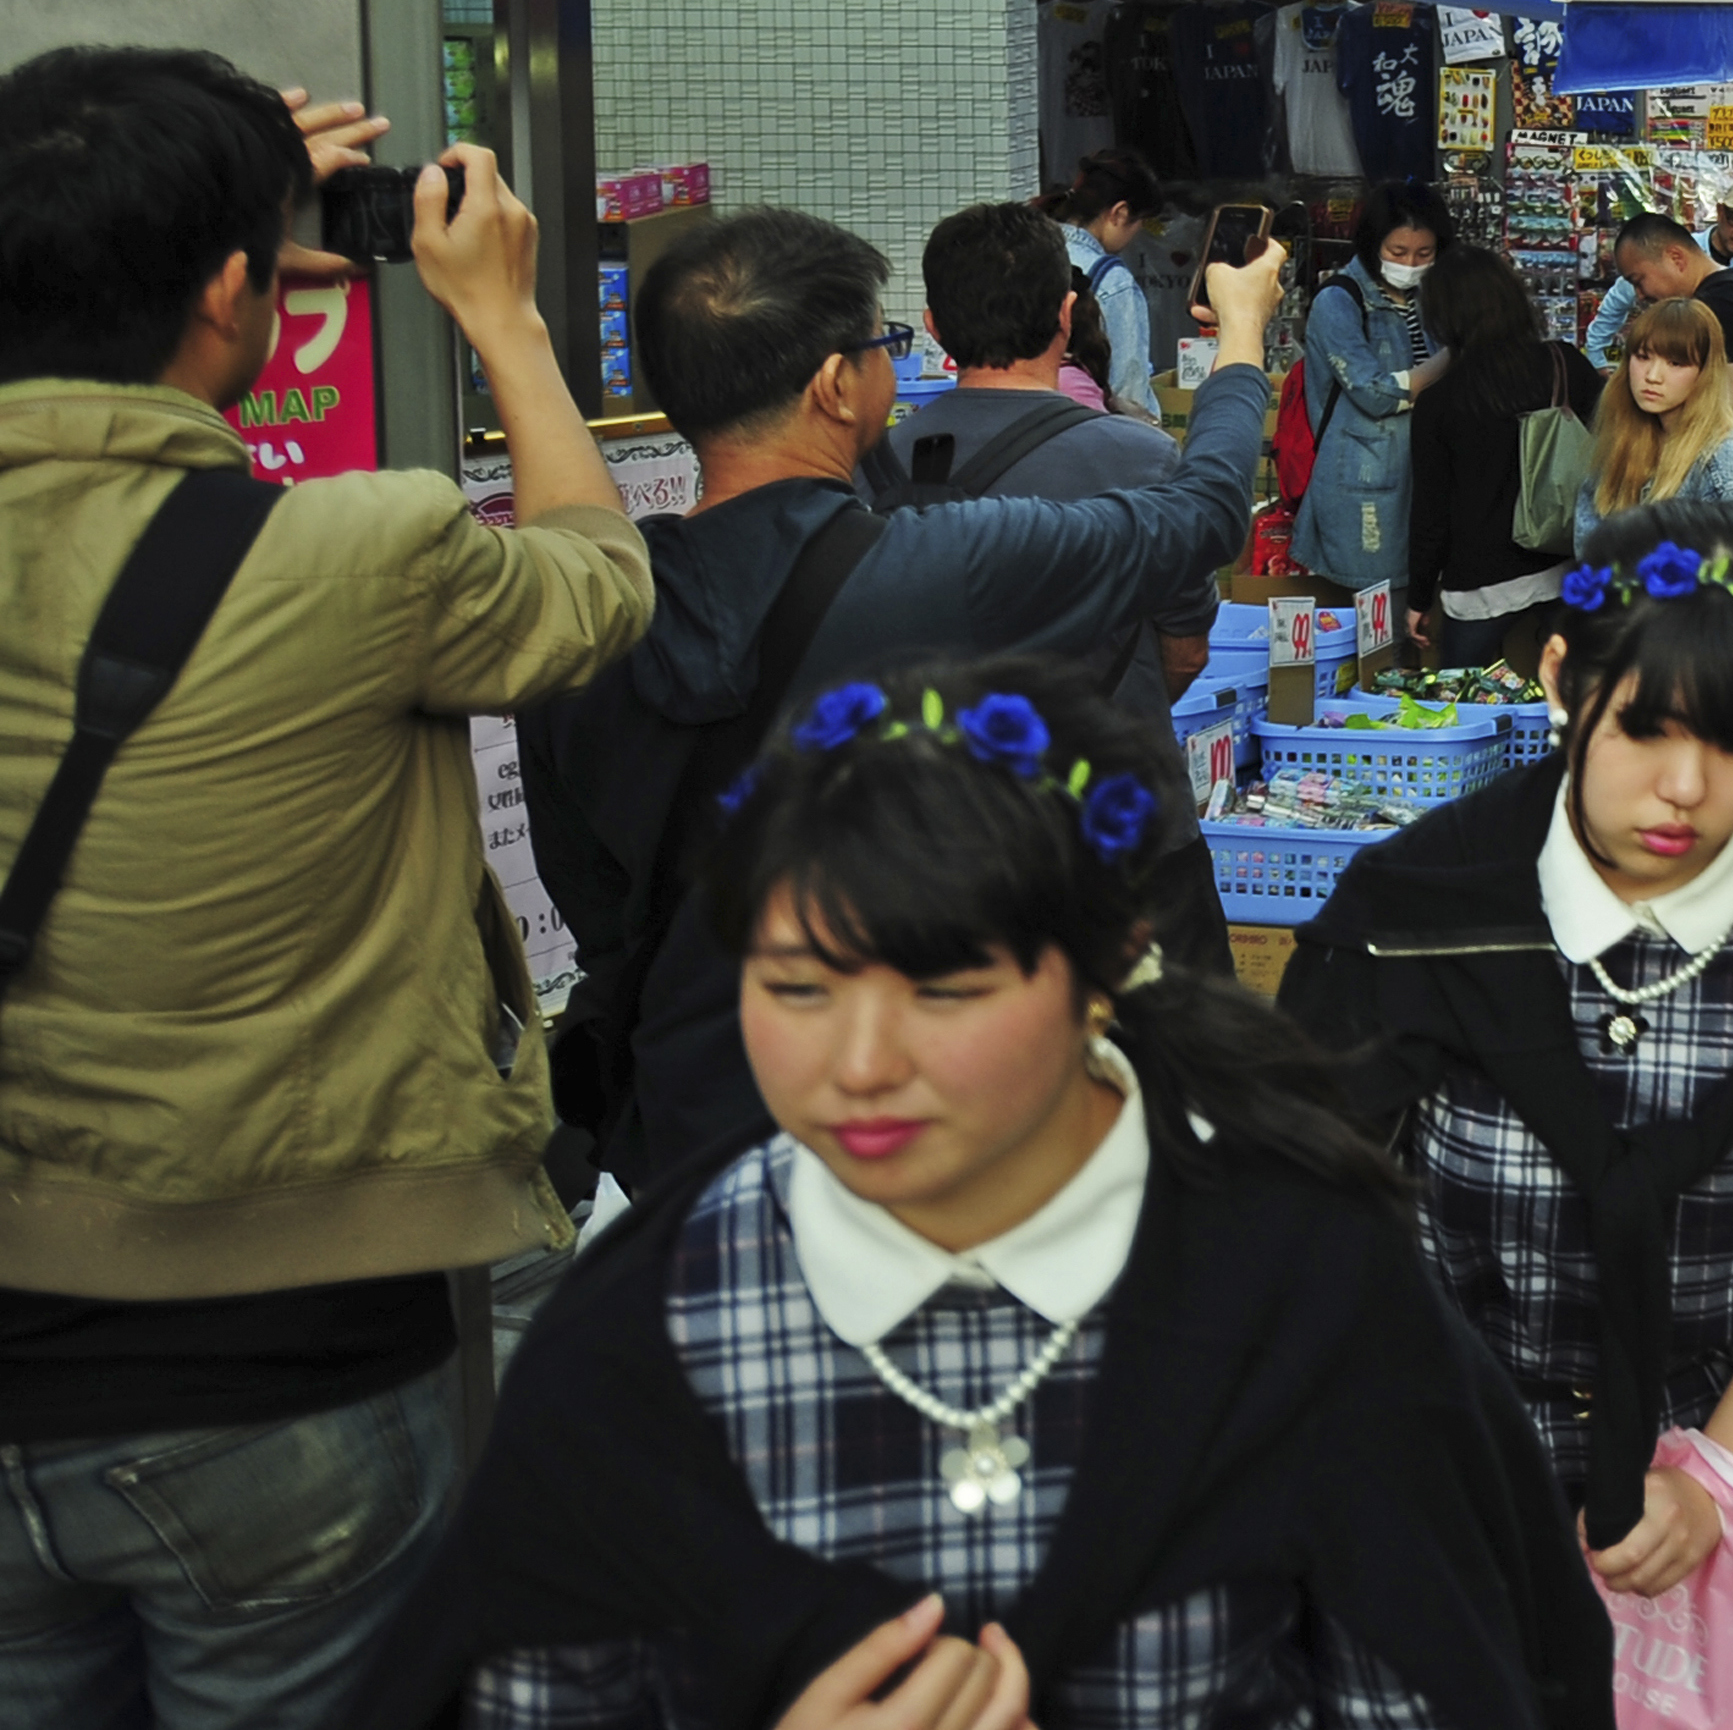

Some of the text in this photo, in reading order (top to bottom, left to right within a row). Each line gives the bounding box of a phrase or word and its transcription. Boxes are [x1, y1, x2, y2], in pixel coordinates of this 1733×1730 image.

[1576, 95, 1635, 113] JAPAN
[1517, 130, 1578, 145] MAGNET
[238, 385, 340, 430] MAP
